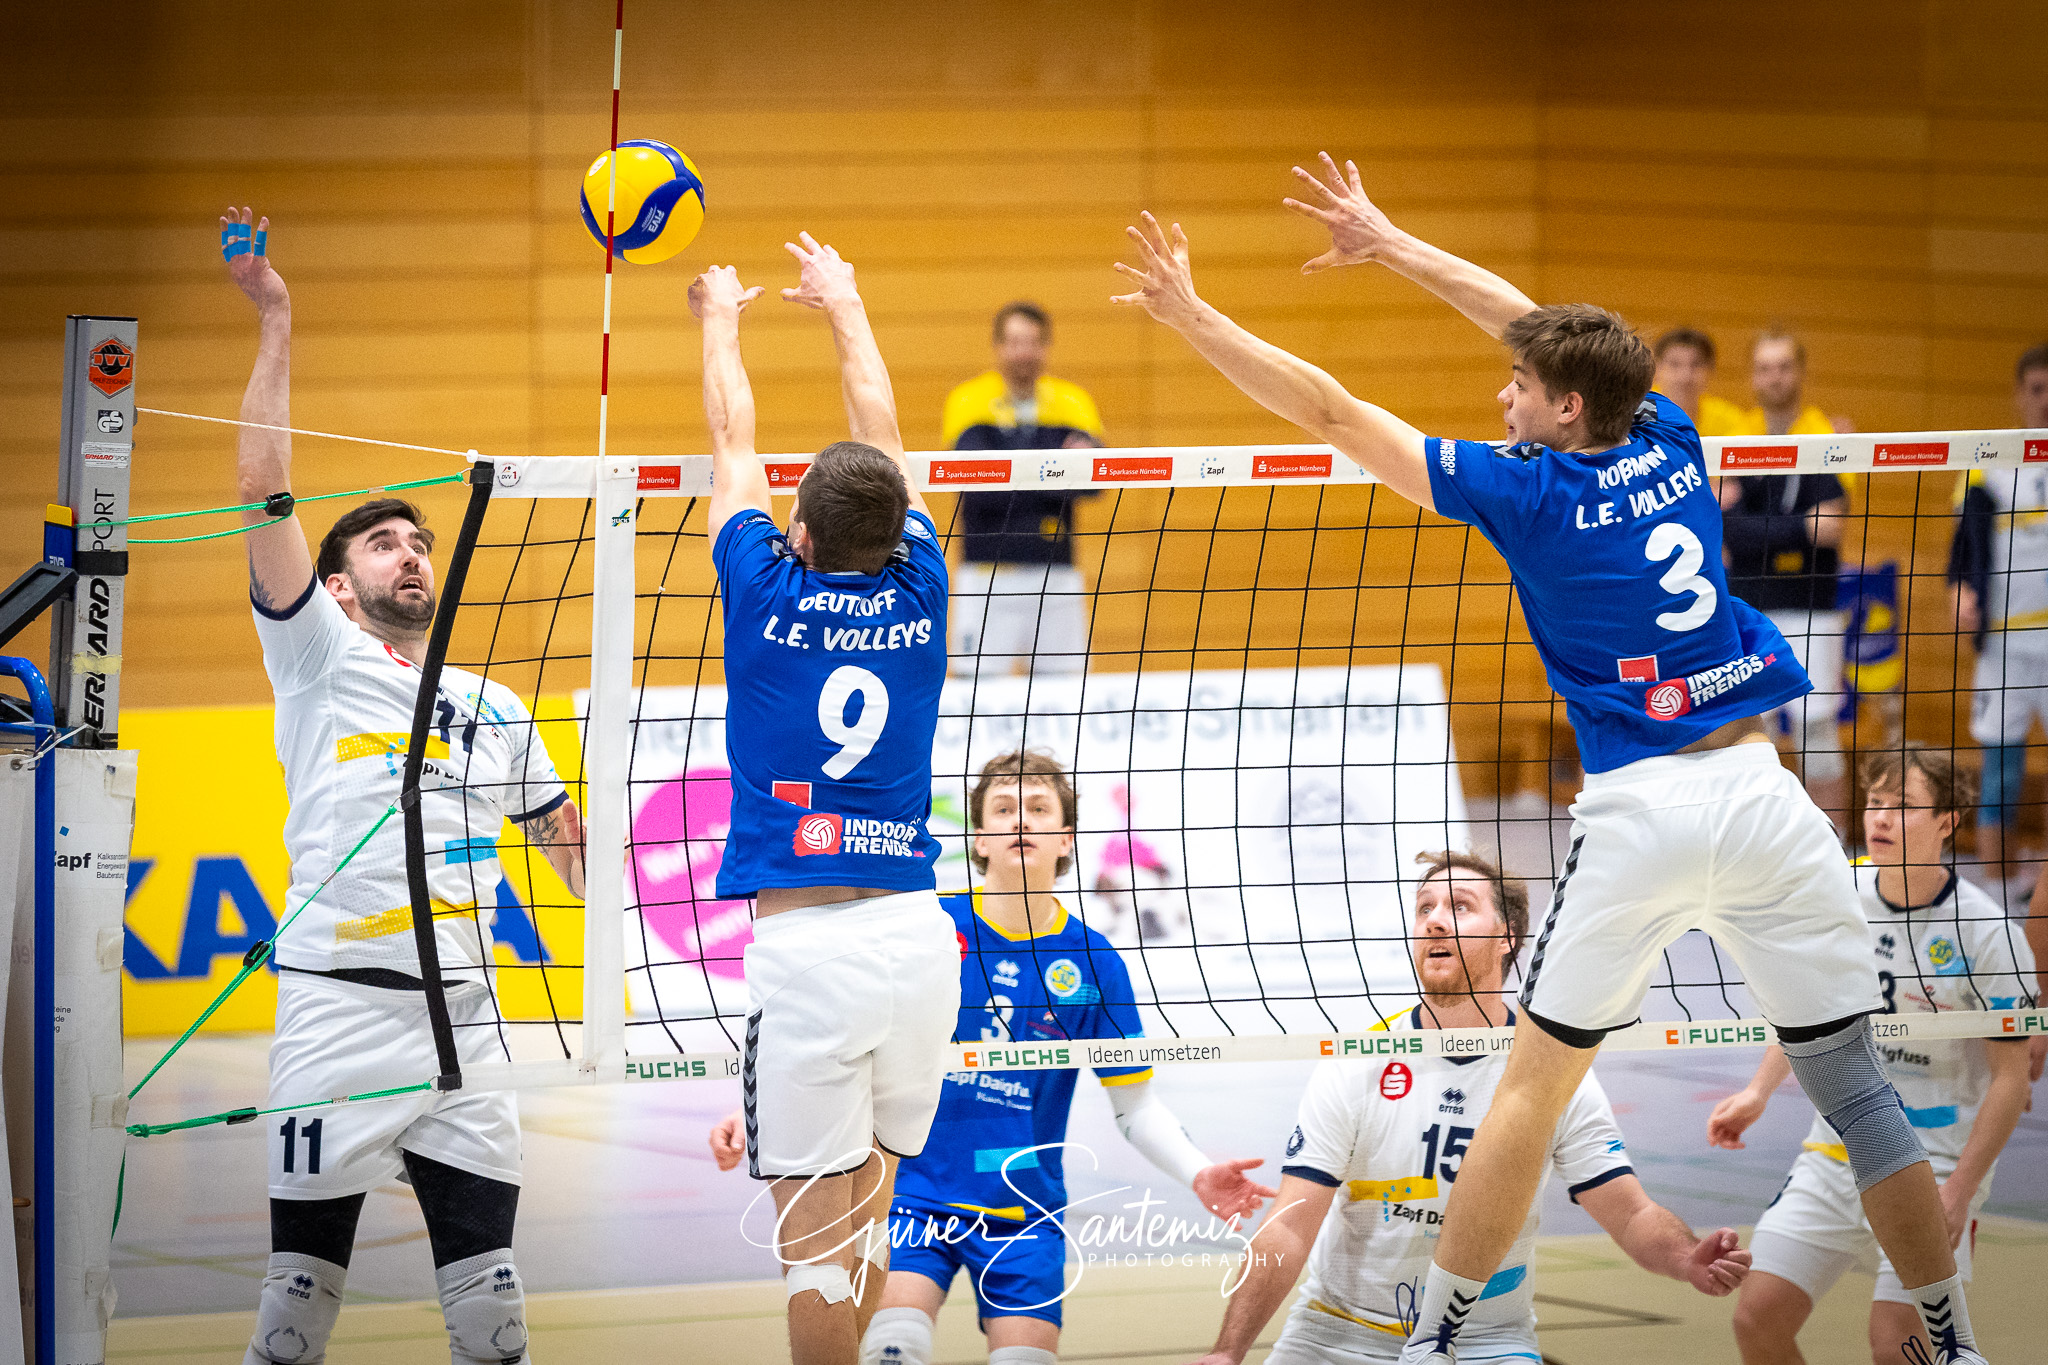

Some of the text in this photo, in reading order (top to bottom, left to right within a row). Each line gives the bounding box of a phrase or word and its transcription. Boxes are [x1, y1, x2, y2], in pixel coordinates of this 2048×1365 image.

[1737, 455, 1793, 464] Sparkasse Nürnberg
[1889, 452, 1944, 461] Sparkasse Nürnberg
[1981, 451, 1999, 459] Zapf
[781, 474, 802, 482] Sparka
[946, 470, 1006, 479] Sparkasse Nürnberg
[1046, 469, 1065, 478] Zapf
[1109, 467, 1167, 476] Sparkasse Nürnberg
[1206, 466, 1225, 475] Zapf
[1268, 464, 1327, 473] Sparkasse Nürnberg
[646, 476, 675, 485] Nürnberg
[1628, 462, 1702, 518] VOLLEYS
[92, 488, 115, 552] PORT
[1644, 522, 1717, 632] 3
[823, 618, 932, 651] VOLLEYS
[84, 578, 110, 730] ERARD
[1690, 656, 1764, 707] TRENDS
[818, 664, 890, 780] 9
[844, 818, 918, 842] INDOOR
[843, 836, 913, 857] TRENDS
[54, 851, 92, 871] apf
[1344, 1037, 1423, 1055] FUCHS
[1440, 1035, 1485, 1053] Ideen
[1689, 1026, 1766, 1044] FUCHS
[988, 1044, 1221, 1067] FUCHS Ideen umsetzen
[625, 1060, 707, 1080] FUCHS
[1438, 1102, 1464, 1115] errea
[279, 1116, 323, 1175] 11
[1421, 1123, 1475, 1184] 15
[287, 1286, 310, 1300] errea
[493, 1280, 515, 1292] errea
